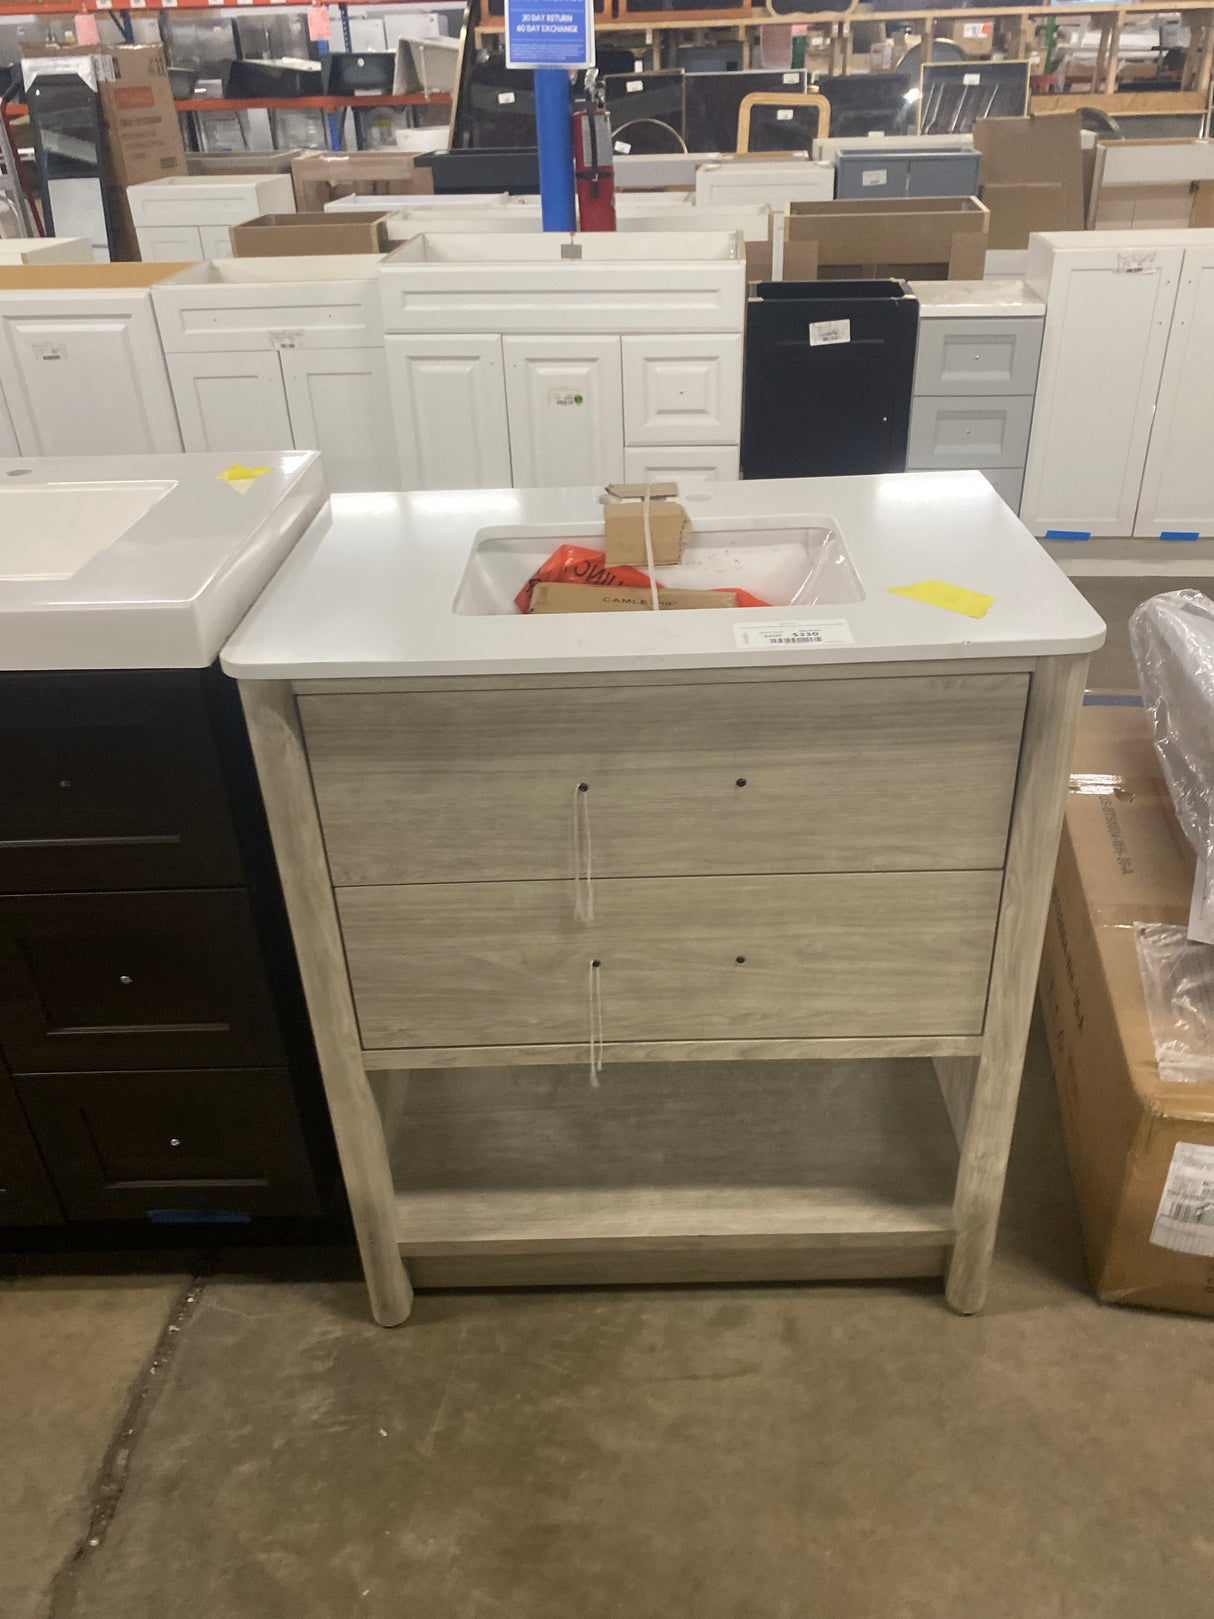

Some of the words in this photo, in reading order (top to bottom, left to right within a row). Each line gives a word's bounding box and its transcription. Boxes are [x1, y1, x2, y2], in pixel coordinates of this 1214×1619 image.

[522, 14, 531, 22] 30
[531, 14, 545, 22] DAY
[546, 14, 573, 23] RETURN
[516, 24, 526, 33] 60
[526, 24, 541, 33] DAY
[541, 25, 578, 33] EXCHANGE
